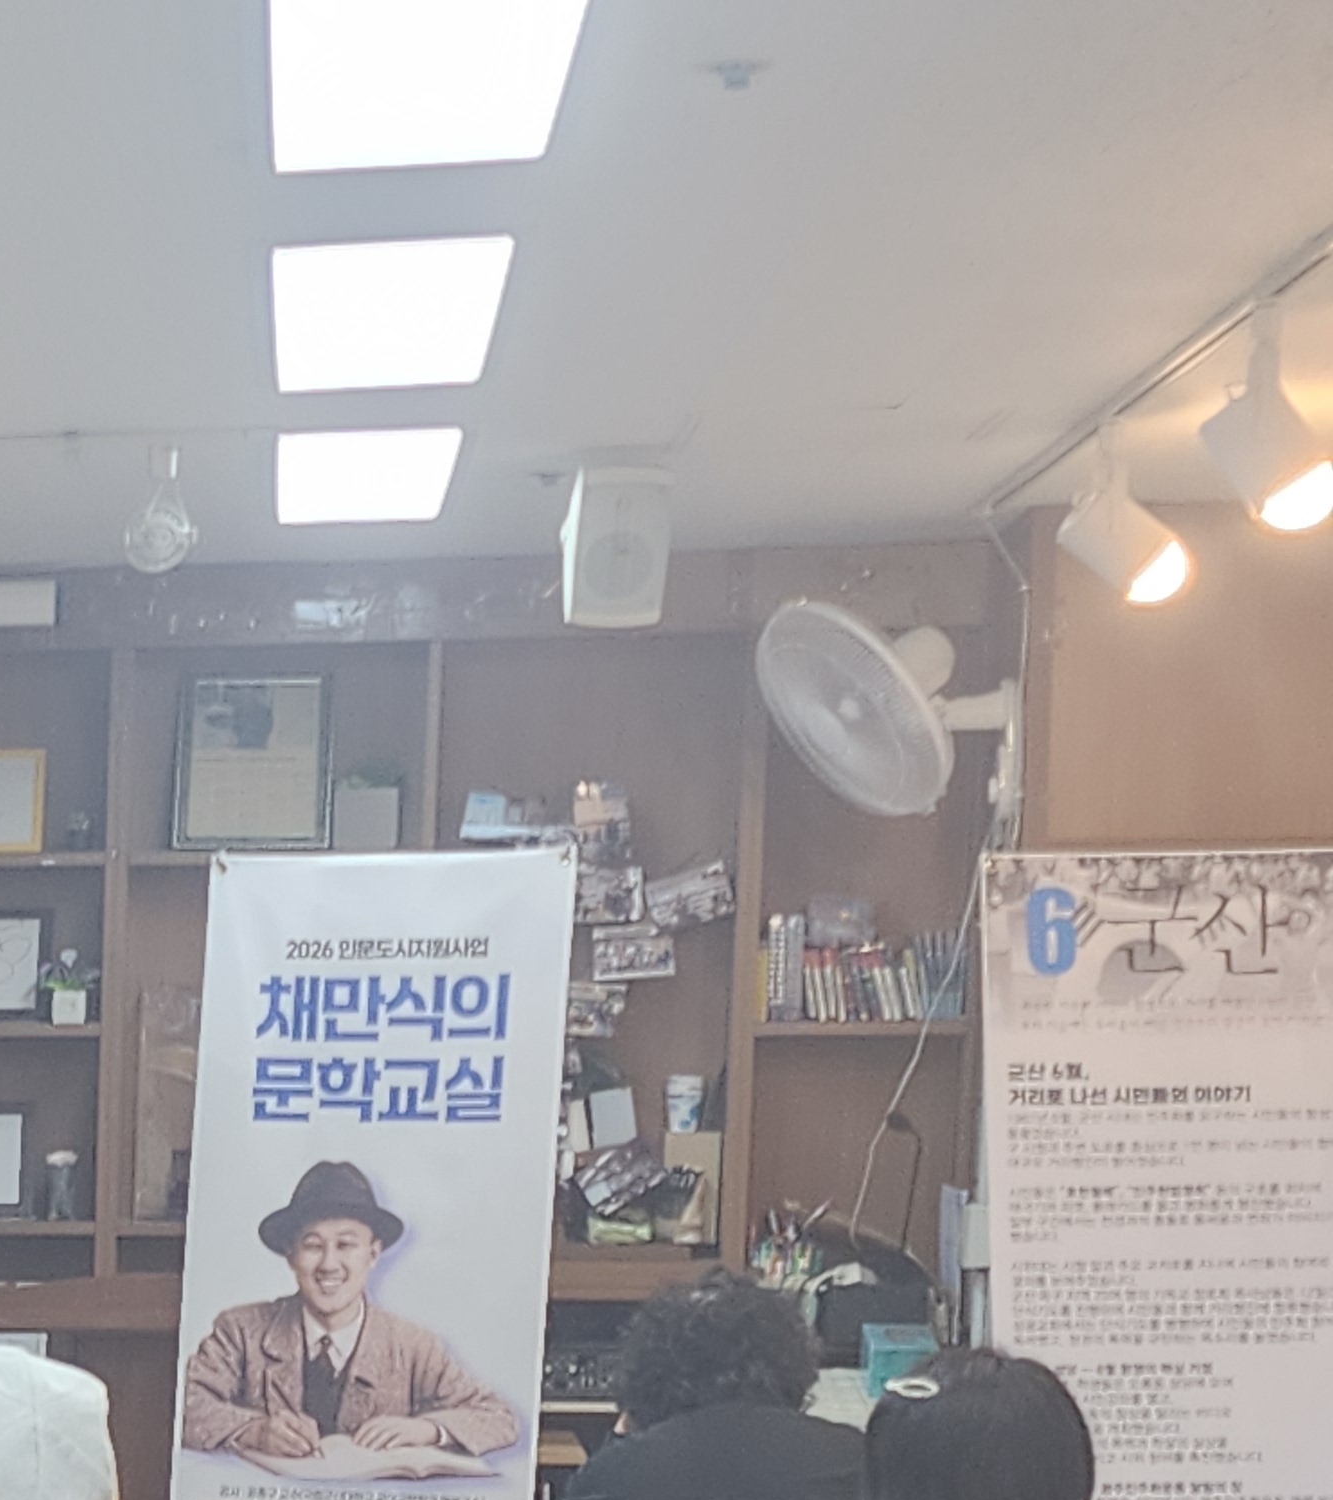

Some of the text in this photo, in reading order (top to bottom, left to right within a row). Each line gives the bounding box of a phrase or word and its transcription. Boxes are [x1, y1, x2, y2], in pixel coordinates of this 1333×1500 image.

[286, 938, 333, 960] 2026
[1025, 885, 1077, 976] 6
[256, 973, 511, 1042] 채만식의
[252, 1055, 505, 1123] 문학교실
[1008, 1085, 1252, 1107] 거리로 나선 시민들의 이야기
